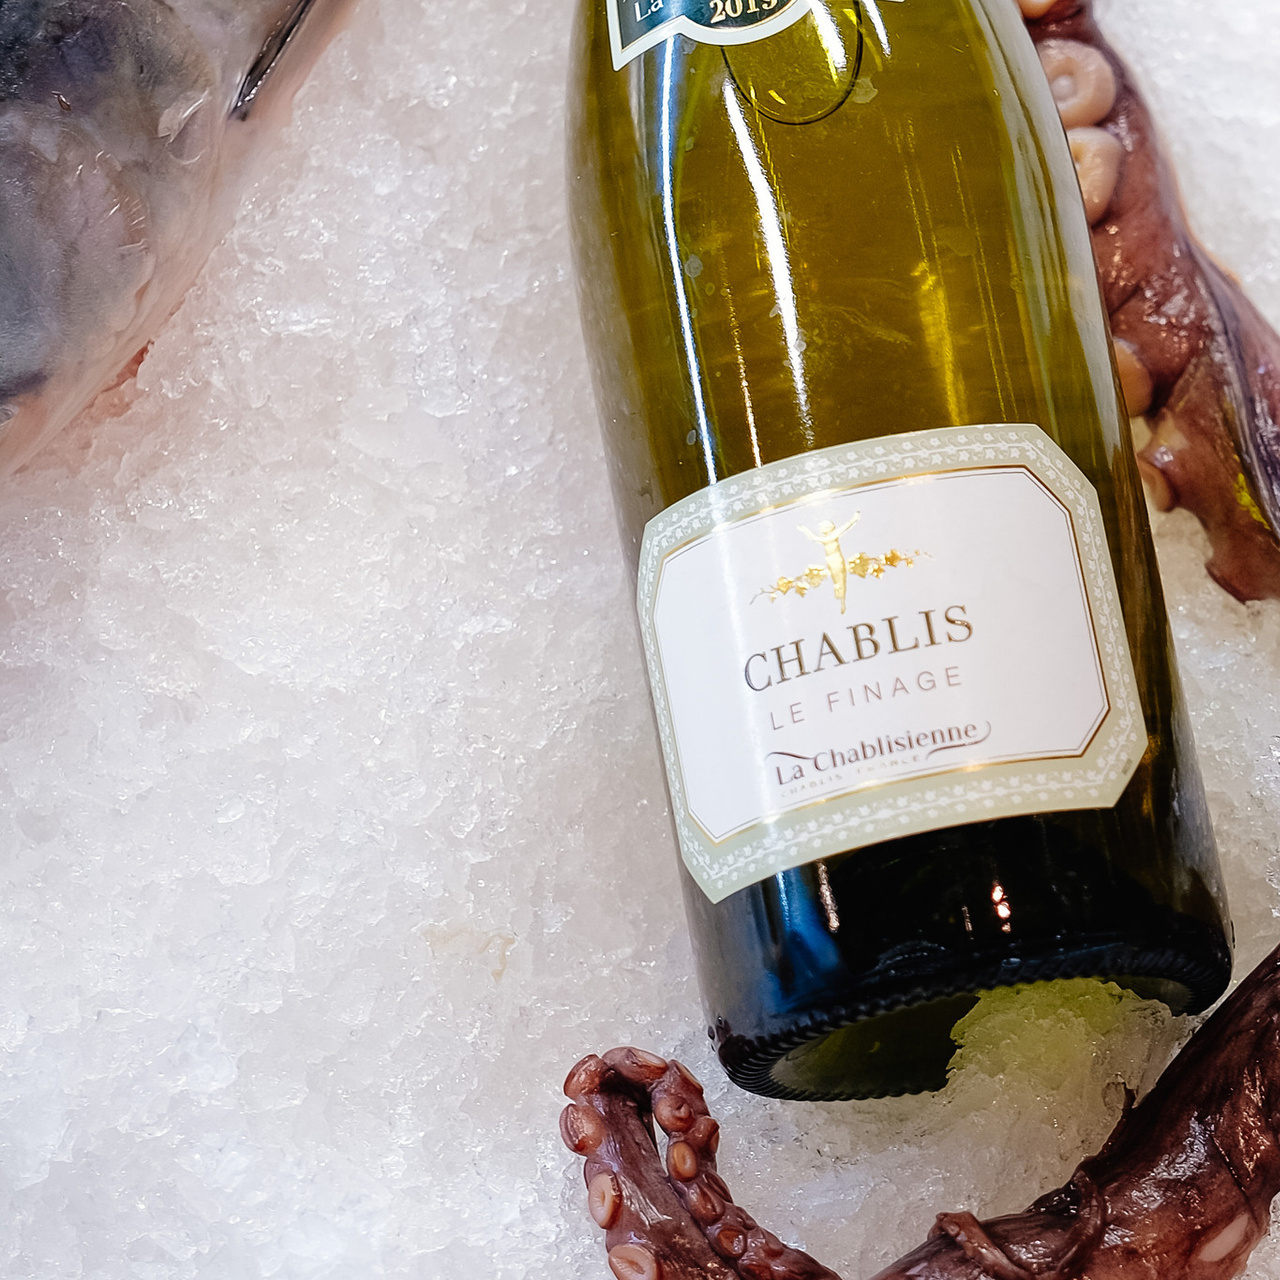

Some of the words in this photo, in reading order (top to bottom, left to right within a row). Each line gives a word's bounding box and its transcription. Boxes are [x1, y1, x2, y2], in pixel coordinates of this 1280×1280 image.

[744, 605, 973, 692] CHABLIS
[770, 702, 805, 731] LE
[827, 665, 962, 712] FINAGE
[776, 764, 806, 786] La
[813, 723, 978, 771] Chablisienne
